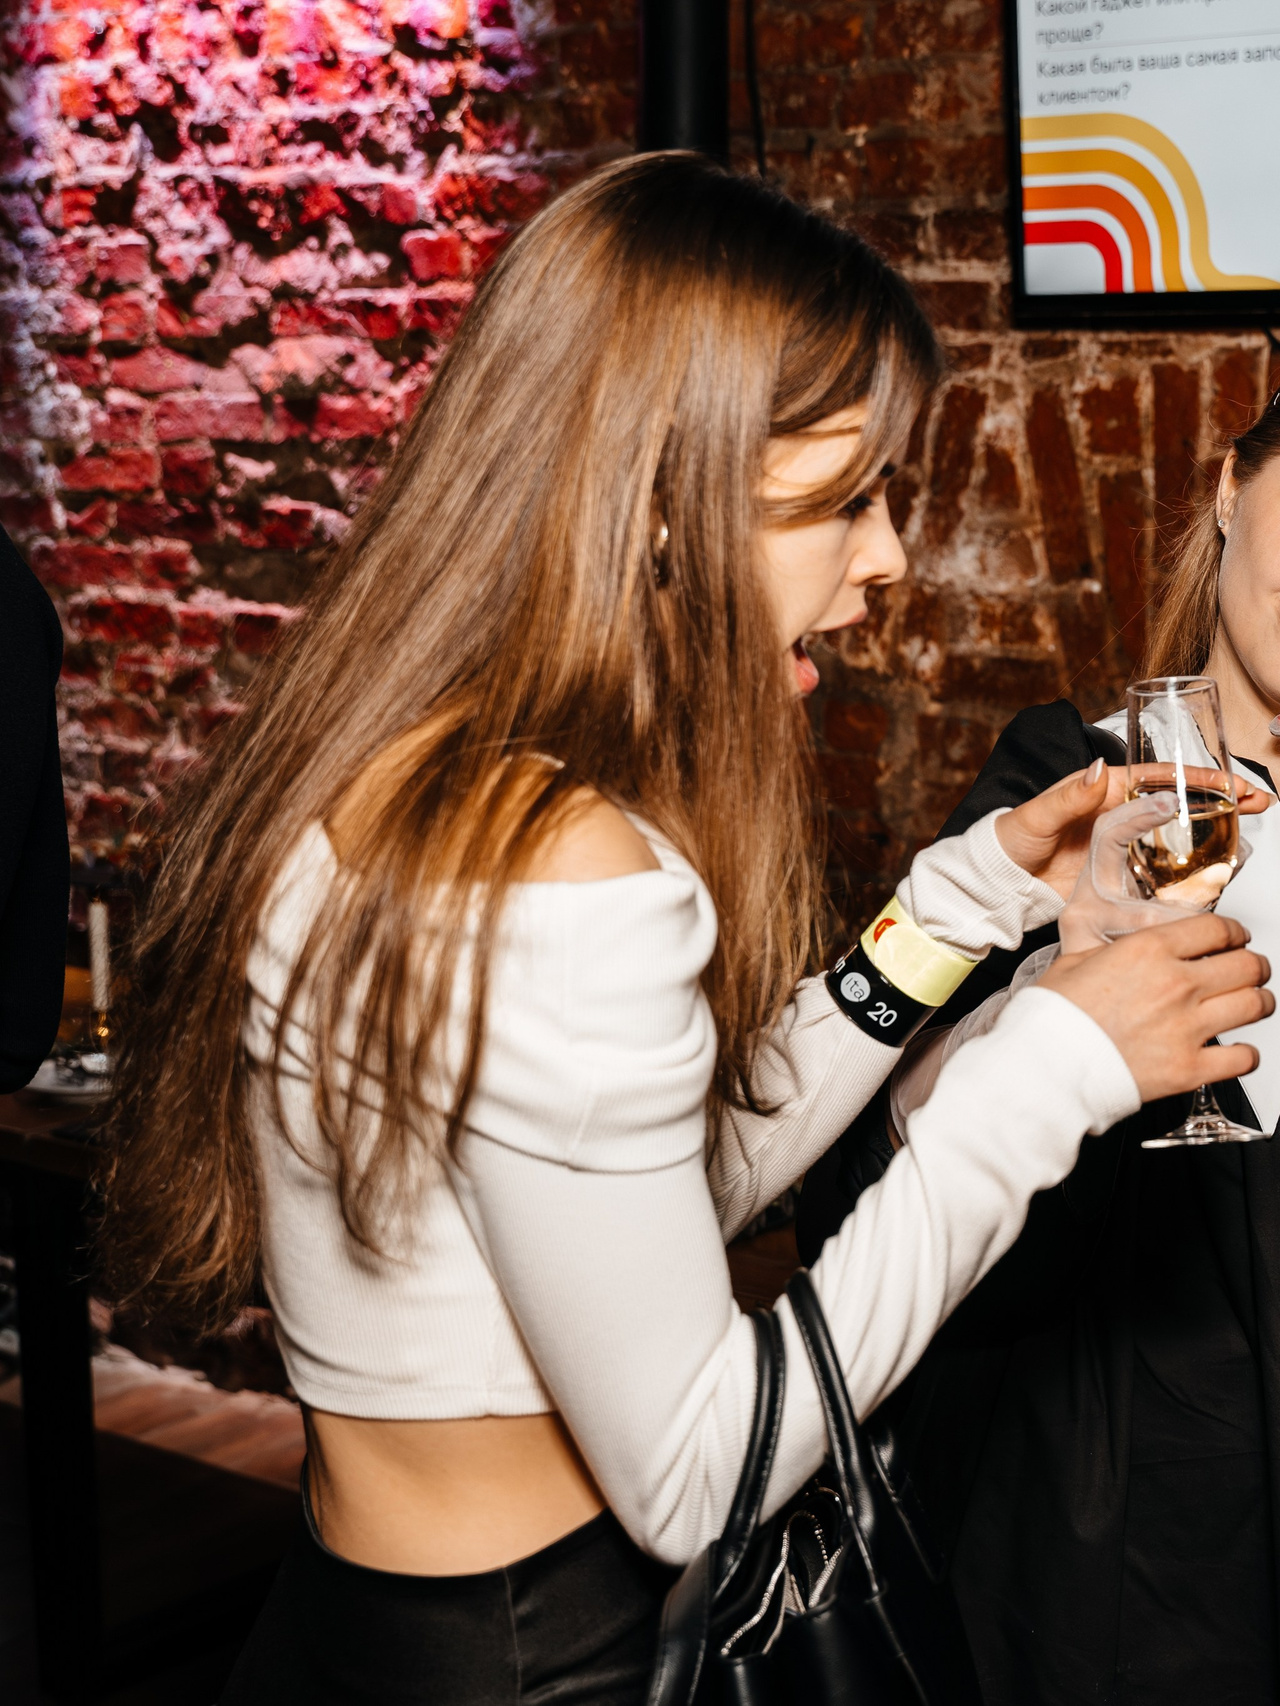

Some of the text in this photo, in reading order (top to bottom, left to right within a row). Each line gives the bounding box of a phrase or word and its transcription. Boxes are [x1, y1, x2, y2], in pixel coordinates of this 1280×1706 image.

[1036, 22, 1104, 47] проще?
[1037, 61, 1086, 77] Какая
[1090, 55, 1134, 74] была
[1138, 54, 1181, 71] ваша
[1186, 50, 1239, 67] самая
[1038, 82, 1131, 105] клиентом?
[866, 1001, 898, 1027] 20
